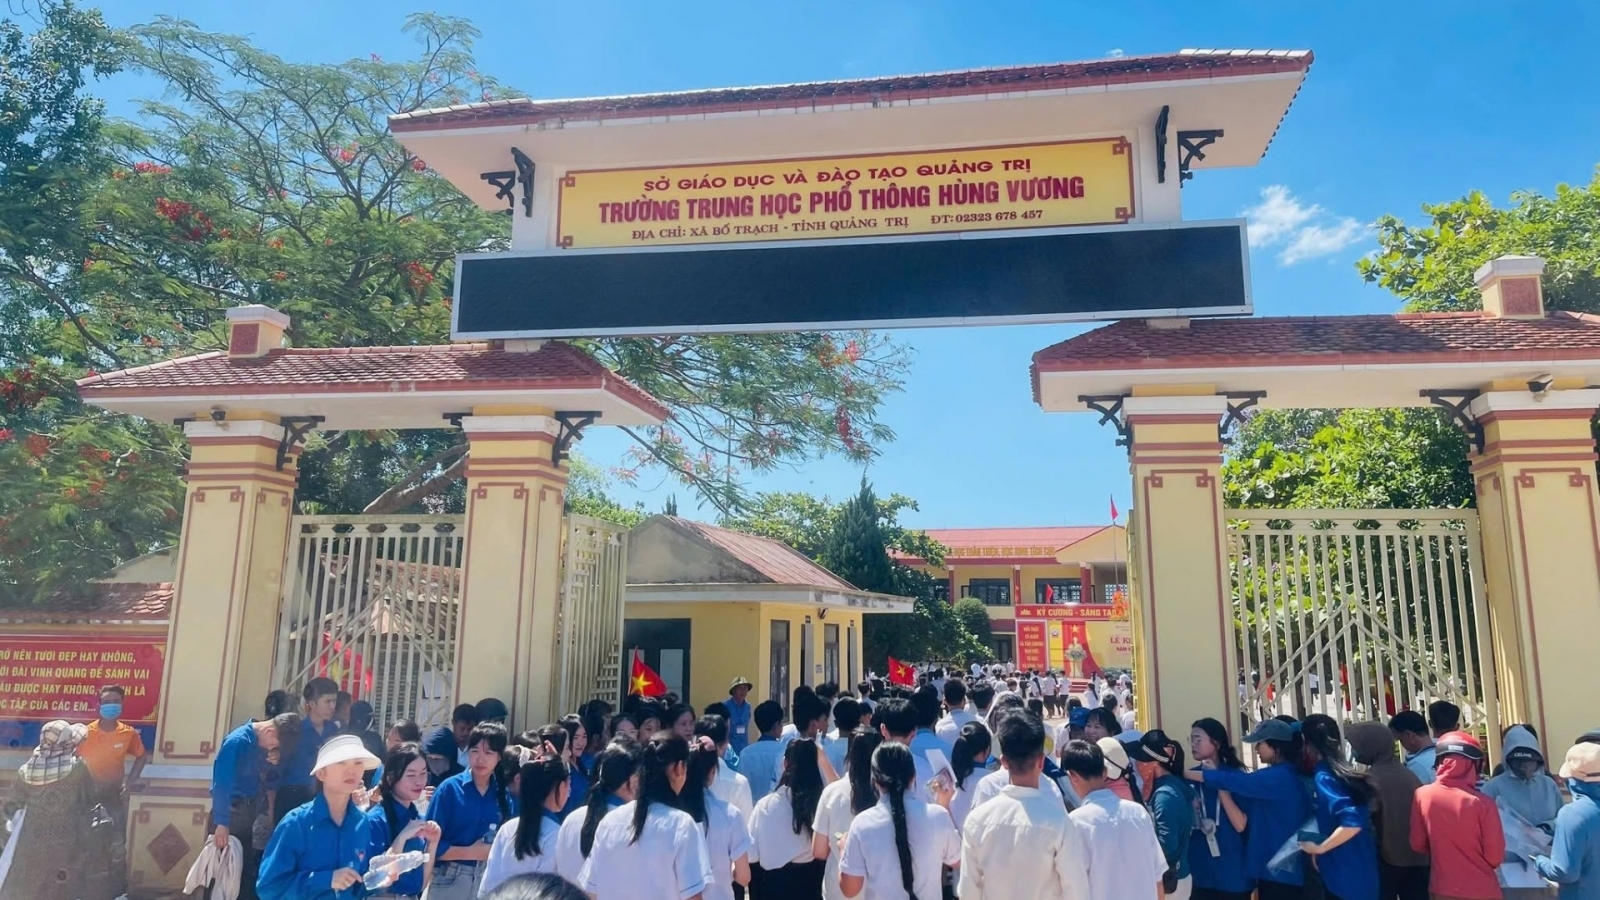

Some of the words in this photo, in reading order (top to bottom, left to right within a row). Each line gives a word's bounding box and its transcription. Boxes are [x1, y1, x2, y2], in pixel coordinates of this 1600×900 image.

[643, 175, 671, 192] SỞ
[677, 173, 727, 190] GIÁO
[733, 174, 775, 190] DỤC
[782, 168, 808, 184] VÀ
[816, 166, 861, 182] ĐÀO
[867, 166, 908, 181] TẠO
[916, 159, 994, 176] QUẢNG
[1001, 158, 1031, 173] TRỊ
[598, 194, 680, 223] TRƯỜNG
[686, 195, 754, 219] TRUNG
[760, 192, 802, 219] HỌC
[809, 180, 852, 213] PHỔ
[858, 182, 931, 210] THÔNG
[938, 178, 999, 206] HÙNG
[1006, 175, 1084, 203] VƯƠNG
[632, 229, 655, 241] ĐỊA
[659, 225, 687, 238] CHỈ:
[689, 225, 709, 236] XÃ
[712, 222, 731, 235] BỐ
[733, 223, 779, 235] TRẠCH
[791, 219, 826, 231] TỈNH
[829, 216, 878, 231] QUẢNG
[884, 216, 909, 228] TRỊ
[994, 211, 1018, 221] 678
[1020, 209, 1043, 220] 457
[0, 648, 11, 660] RỞ
[13, 649, 31, 661] NÊN
[34, 650, 56, 661] TƯƠI
[58, 651, 77, 663] ĐẸP
[80, 651, 98, 662] HAY
[101, 650, 136, 664] KHÔNG,
[0, 665, 9, 677] ỚI
[30, 667, 53, 677] VINH
[55, 668, 87, 678] QUANG
[90, 664, 104, 678] ĐỂ
[105, 666, 131, 678] SÁNH
[133, 669, 150, 679] VAI
[14, 682, 40, 695] ĐƯỢC
[42, 684, 61, 694] HAY
[63, 683, 98, 696] KHÔNG,
[134, 684, 146, 696] LÀ
[10, 697, 28, 711] TẬP
[30, 698, 49, 710] CỦA
[52, 698, 71, 711] CÁC
